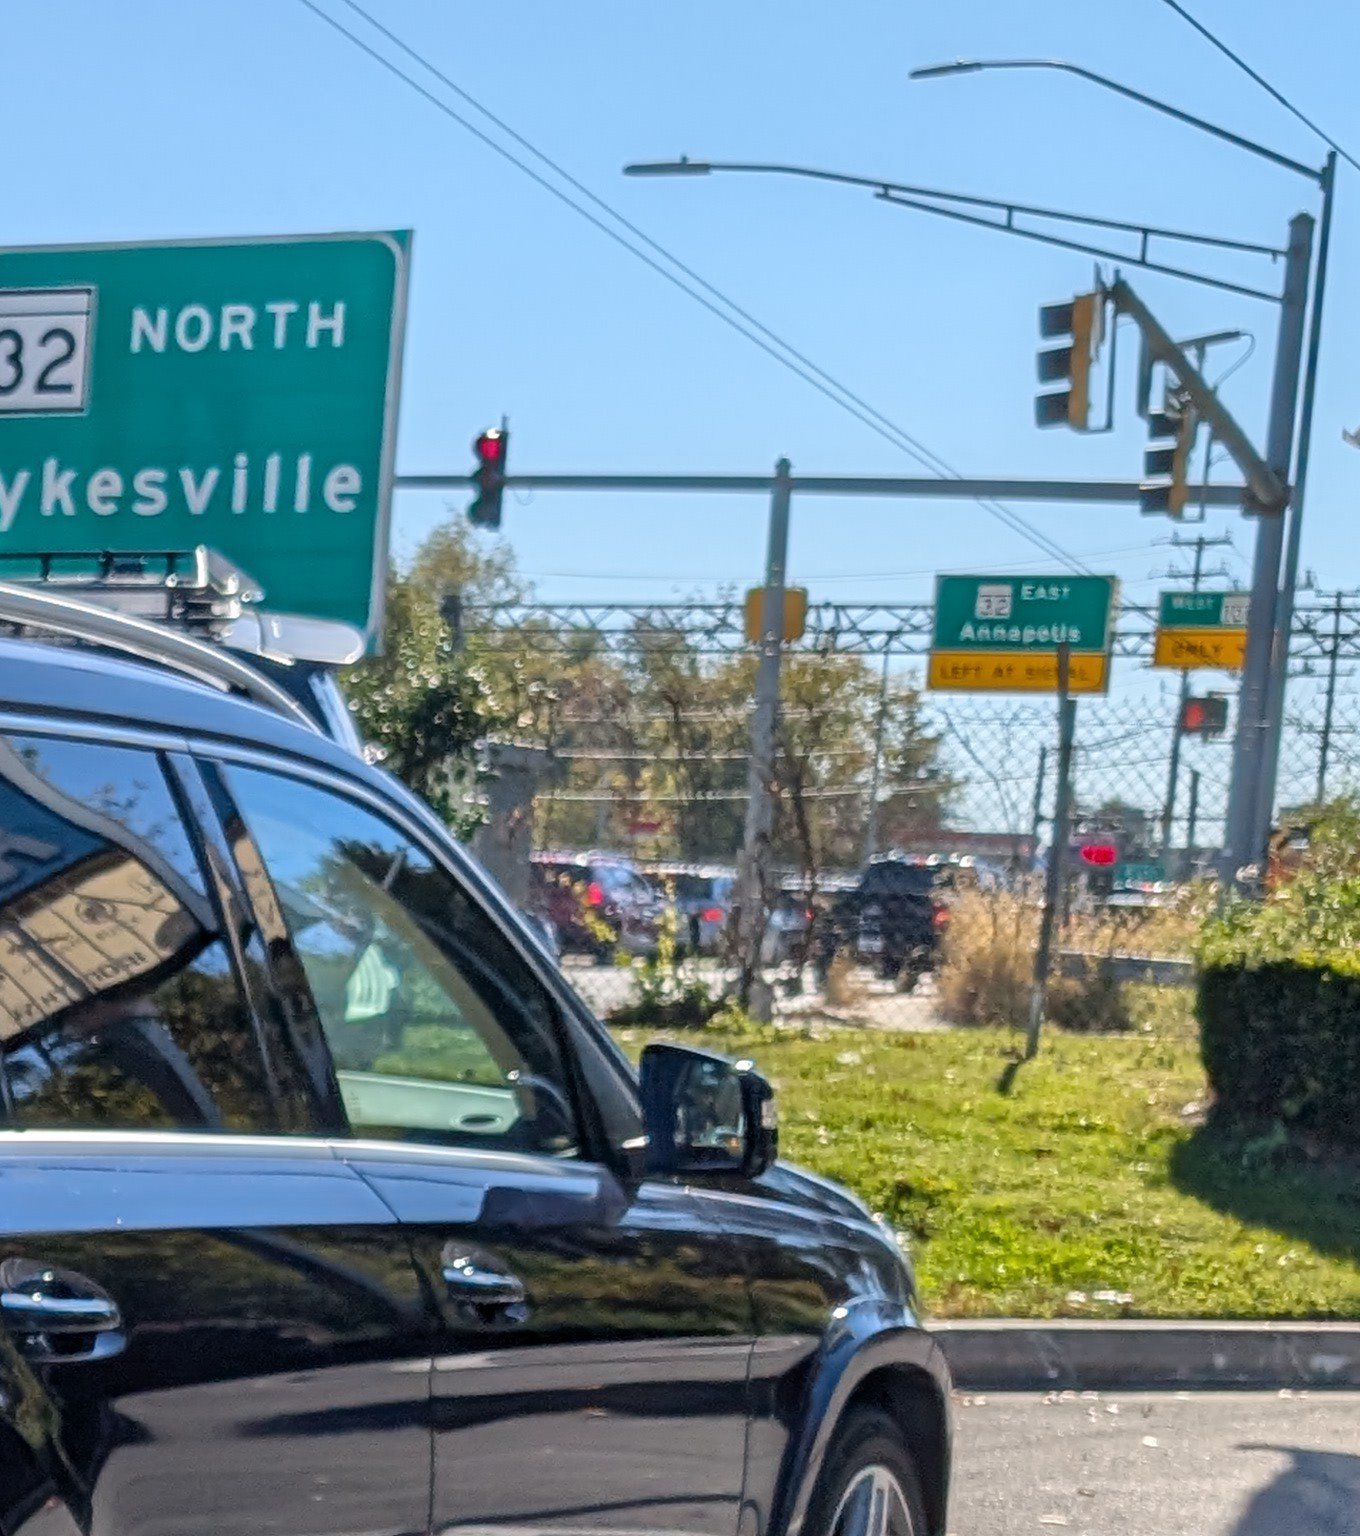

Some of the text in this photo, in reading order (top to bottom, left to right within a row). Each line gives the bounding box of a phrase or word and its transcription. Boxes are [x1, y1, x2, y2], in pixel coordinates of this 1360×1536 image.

[129, 301, 346, 354] NORTH
[1020, 584, 1071, 601] EAST
[959, 621, 1081, 645] Annapolis
